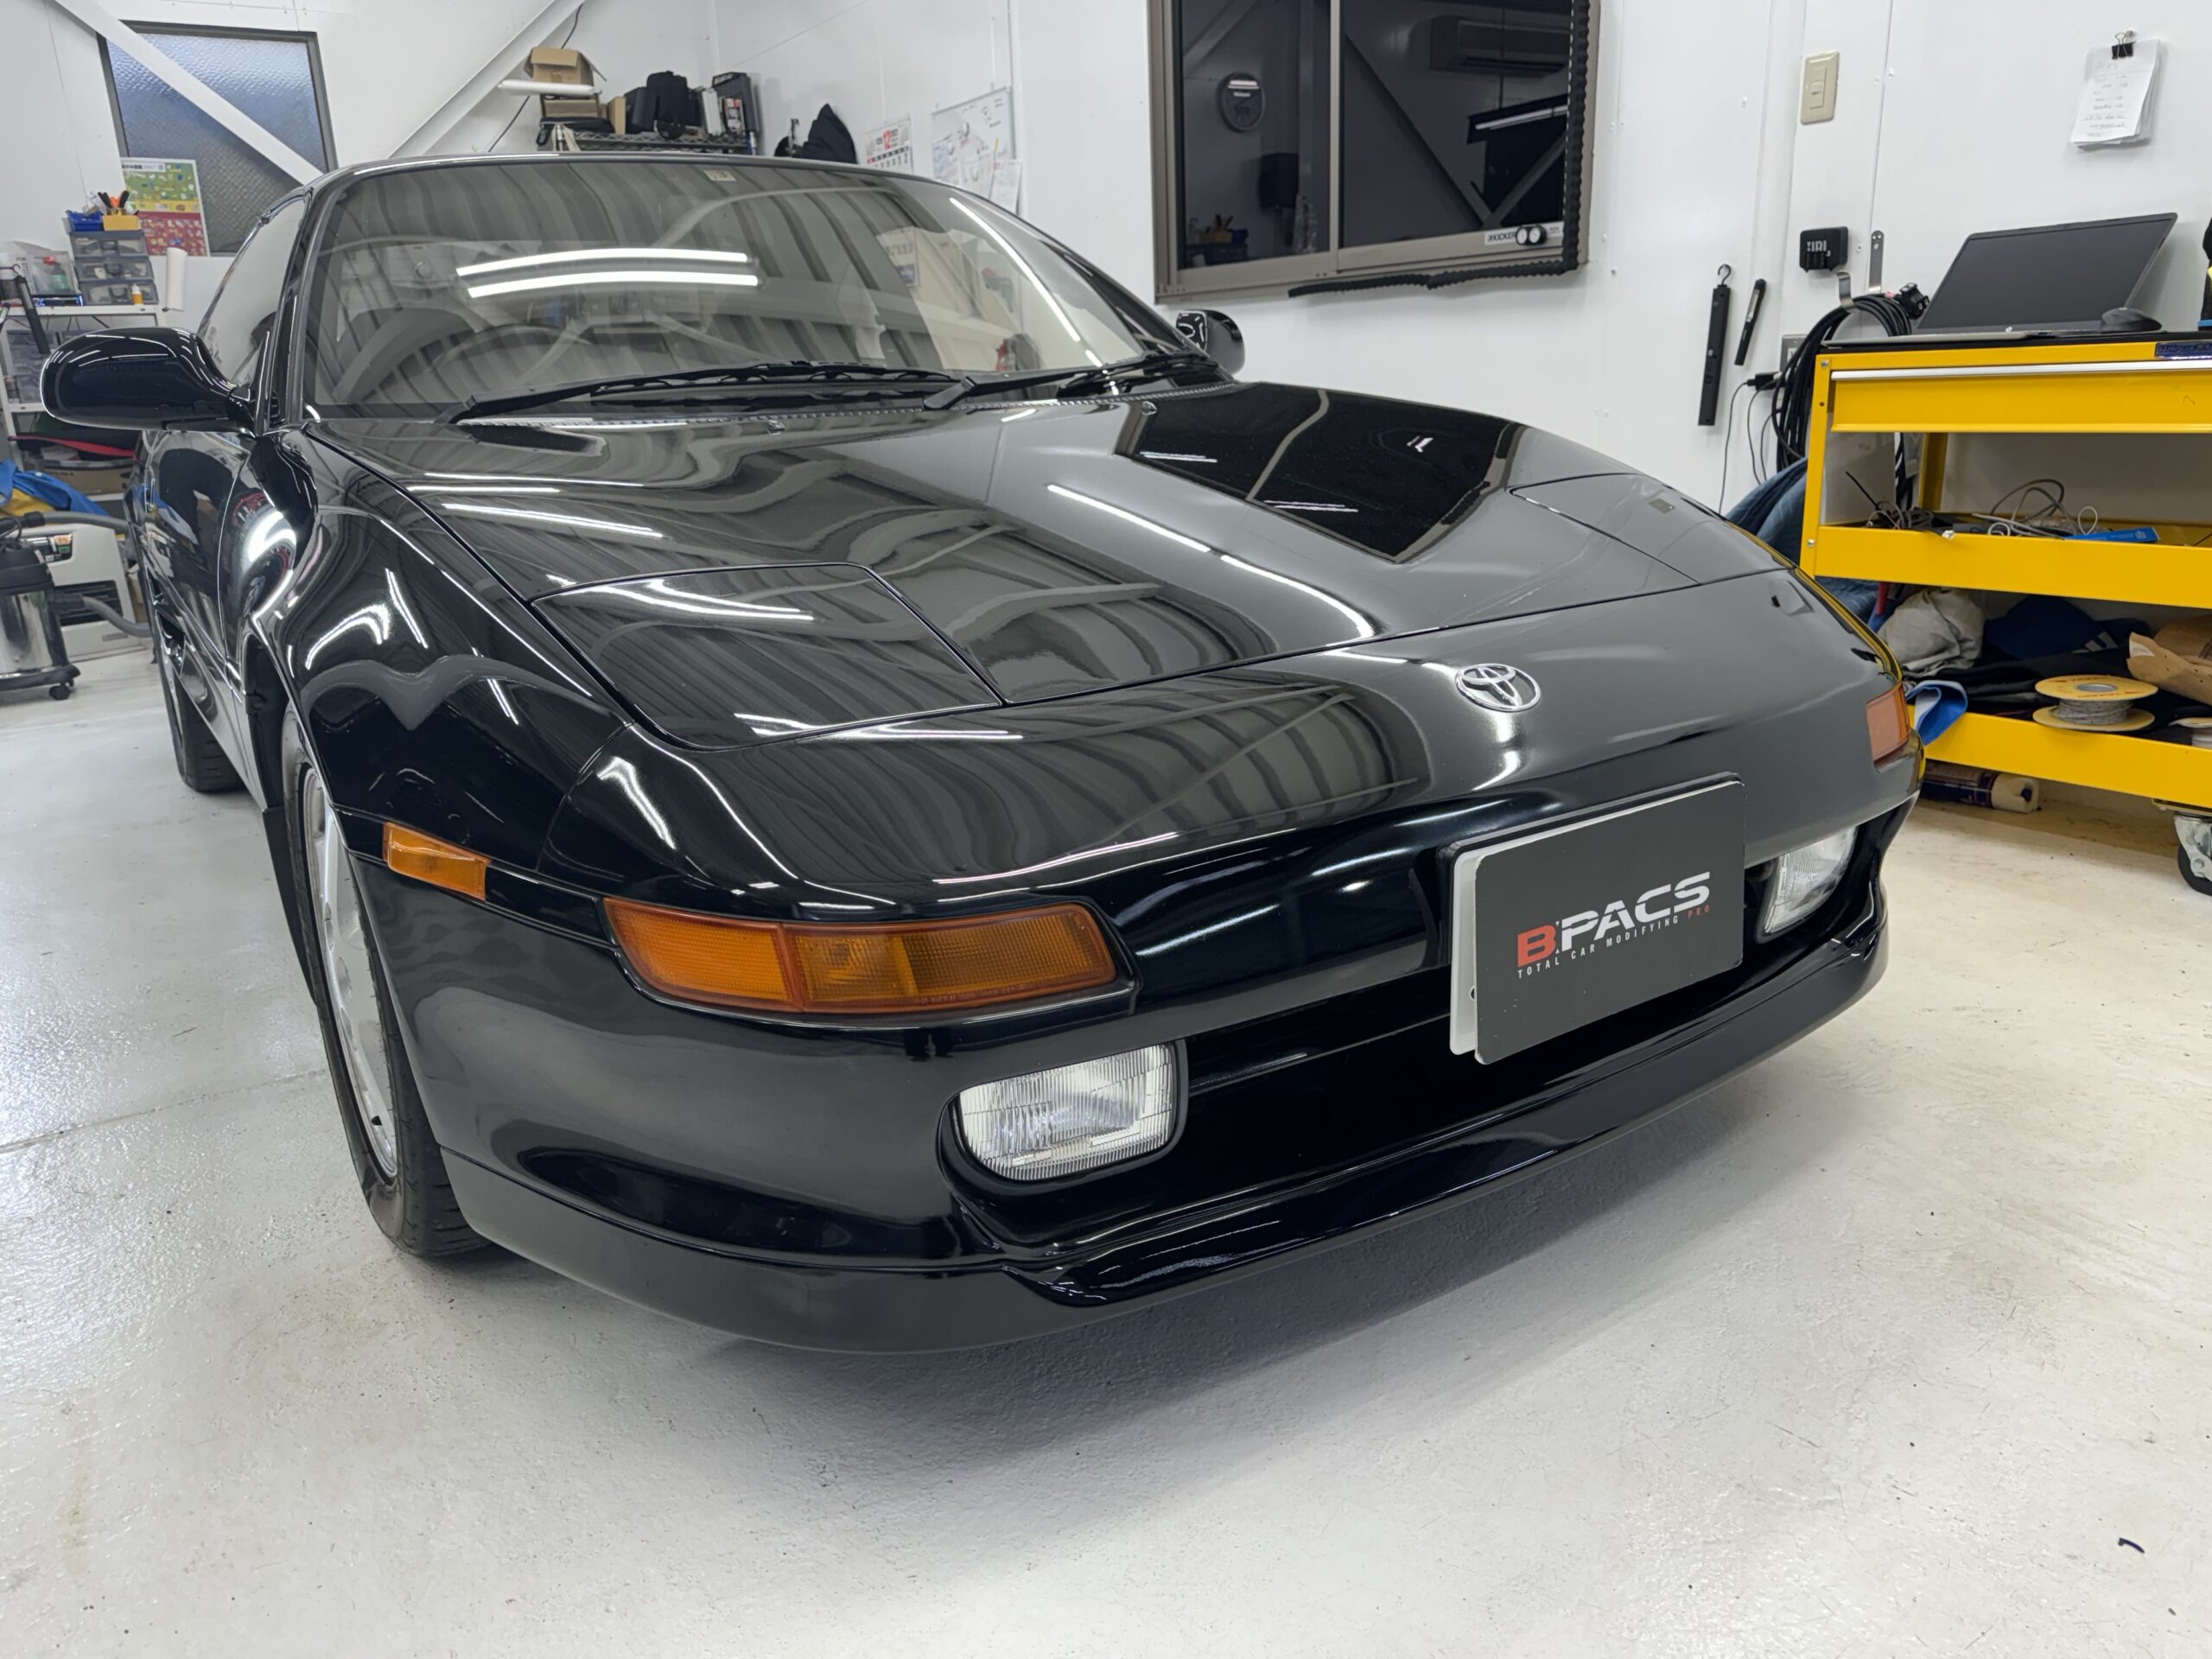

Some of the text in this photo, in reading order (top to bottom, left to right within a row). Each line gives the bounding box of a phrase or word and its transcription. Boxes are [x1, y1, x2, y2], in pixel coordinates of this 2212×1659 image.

[1517, 905, 1710, 979] TOTAL CAR MODIFYING PRO
